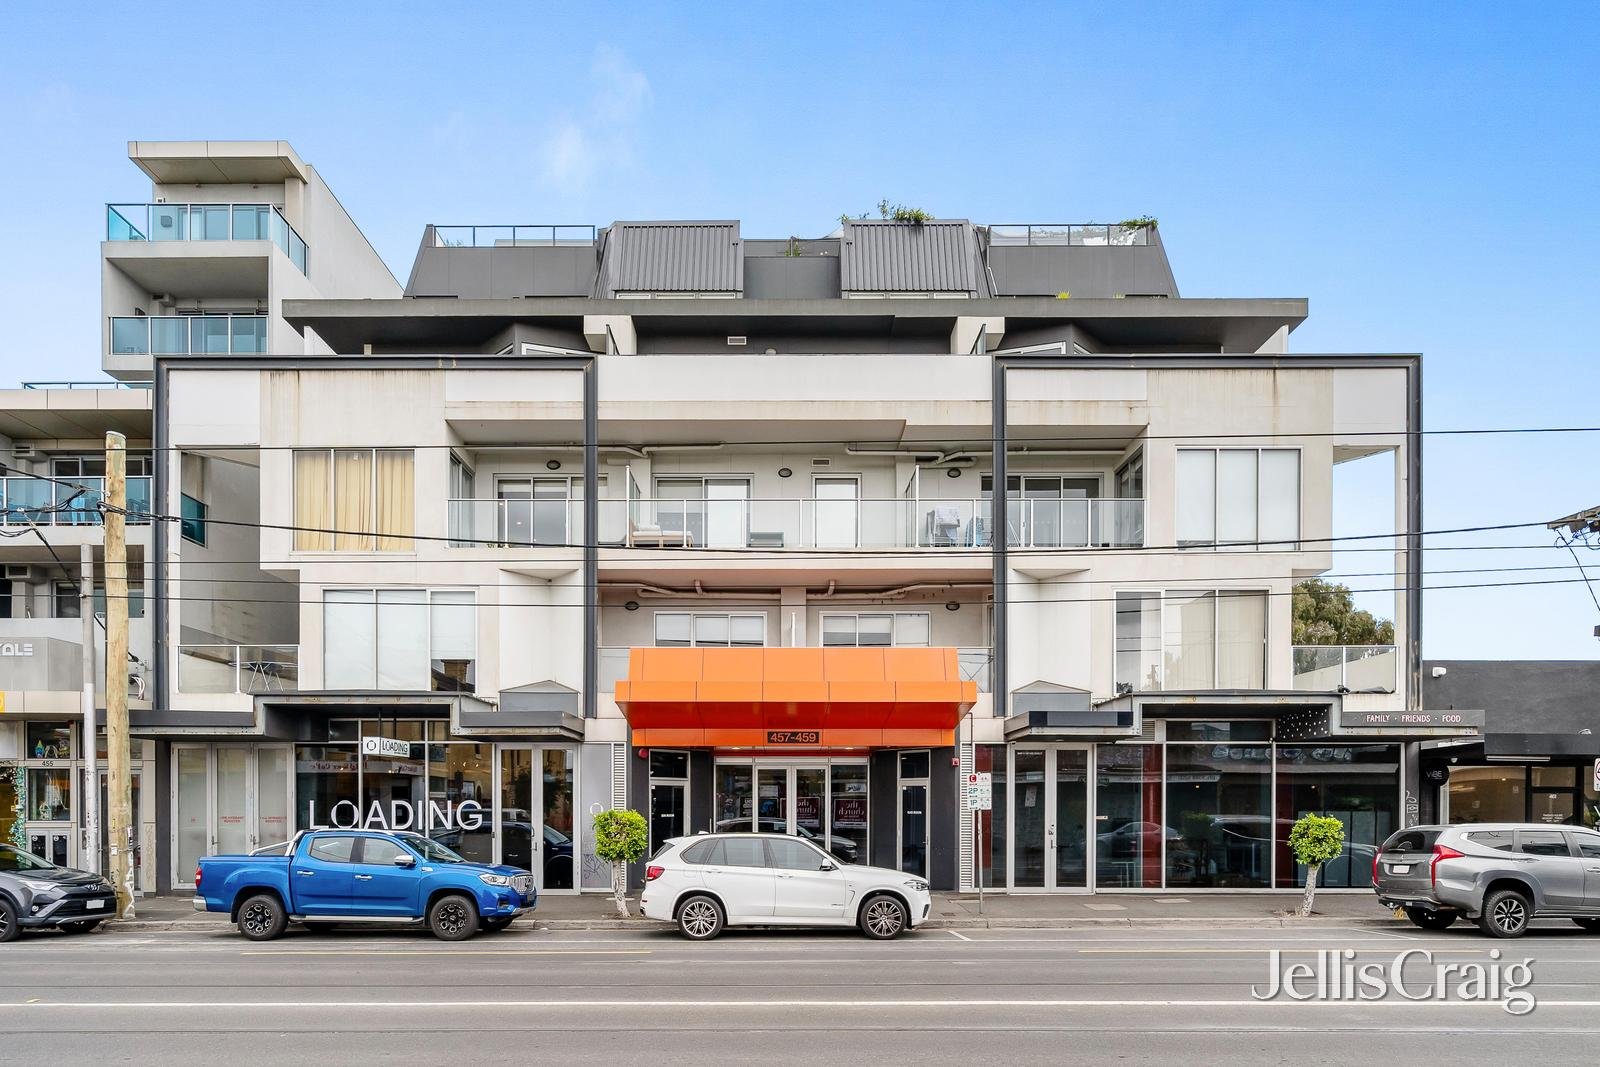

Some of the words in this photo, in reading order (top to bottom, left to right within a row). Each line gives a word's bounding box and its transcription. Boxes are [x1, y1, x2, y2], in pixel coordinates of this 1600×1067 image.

[1366, 714, 1390, 723] FAMILY
[1401, 714, 1431, 723] FRIENDS
[1442, 714, 1462, 723] FOOD
[770, 732, 817, 742] 457-459
[382, 740, 408, 753] LOADING
[309, 799, 483, 831] LOADING
